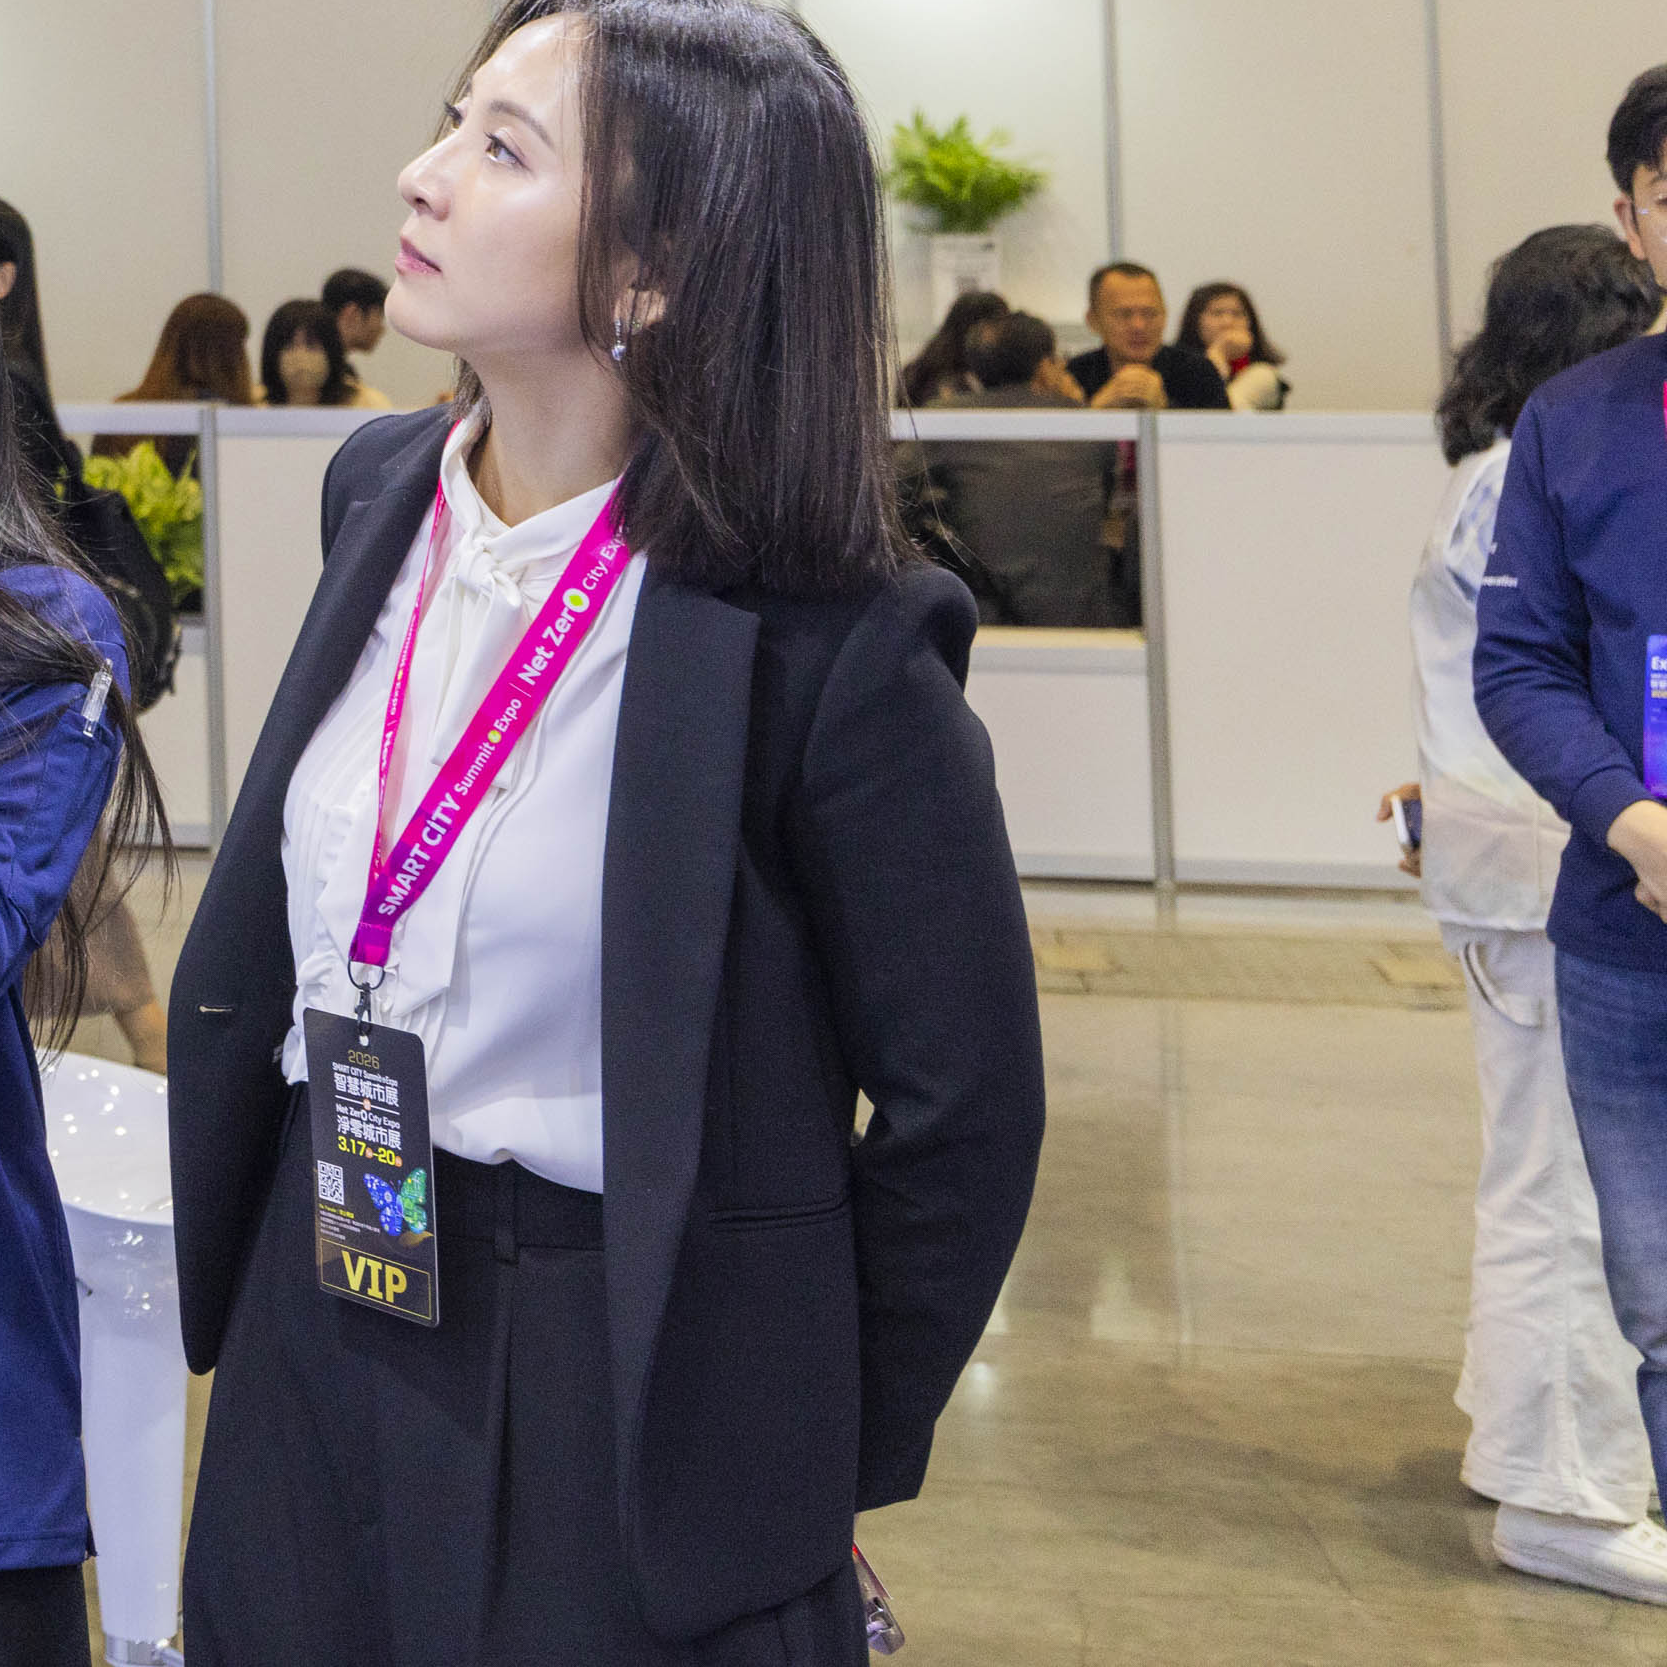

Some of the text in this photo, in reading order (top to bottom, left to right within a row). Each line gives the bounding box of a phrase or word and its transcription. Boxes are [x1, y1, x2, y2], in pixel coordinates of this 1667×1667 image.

[517, 644, 555, 687] Net
[582, 559, 610, 592] City
[377, 842, 431, 916] SMART
[421, 791, 462, 847] CITY
[453, 740, 496, 797] Summit
[493, 698, 523, 733] Expo
[347, 1048, 380, 1070] 2026
[334, 1072, 400, 1108] 智慧城市展
[335, 1103, 349, 1115] Net
[368, 1112, 382, 1126] City
[382, 1115, 401, 1130] Expo
[337, 1114, 402, 1151] 淨零城市展
[341, 1250, 408, 1304] VIP
